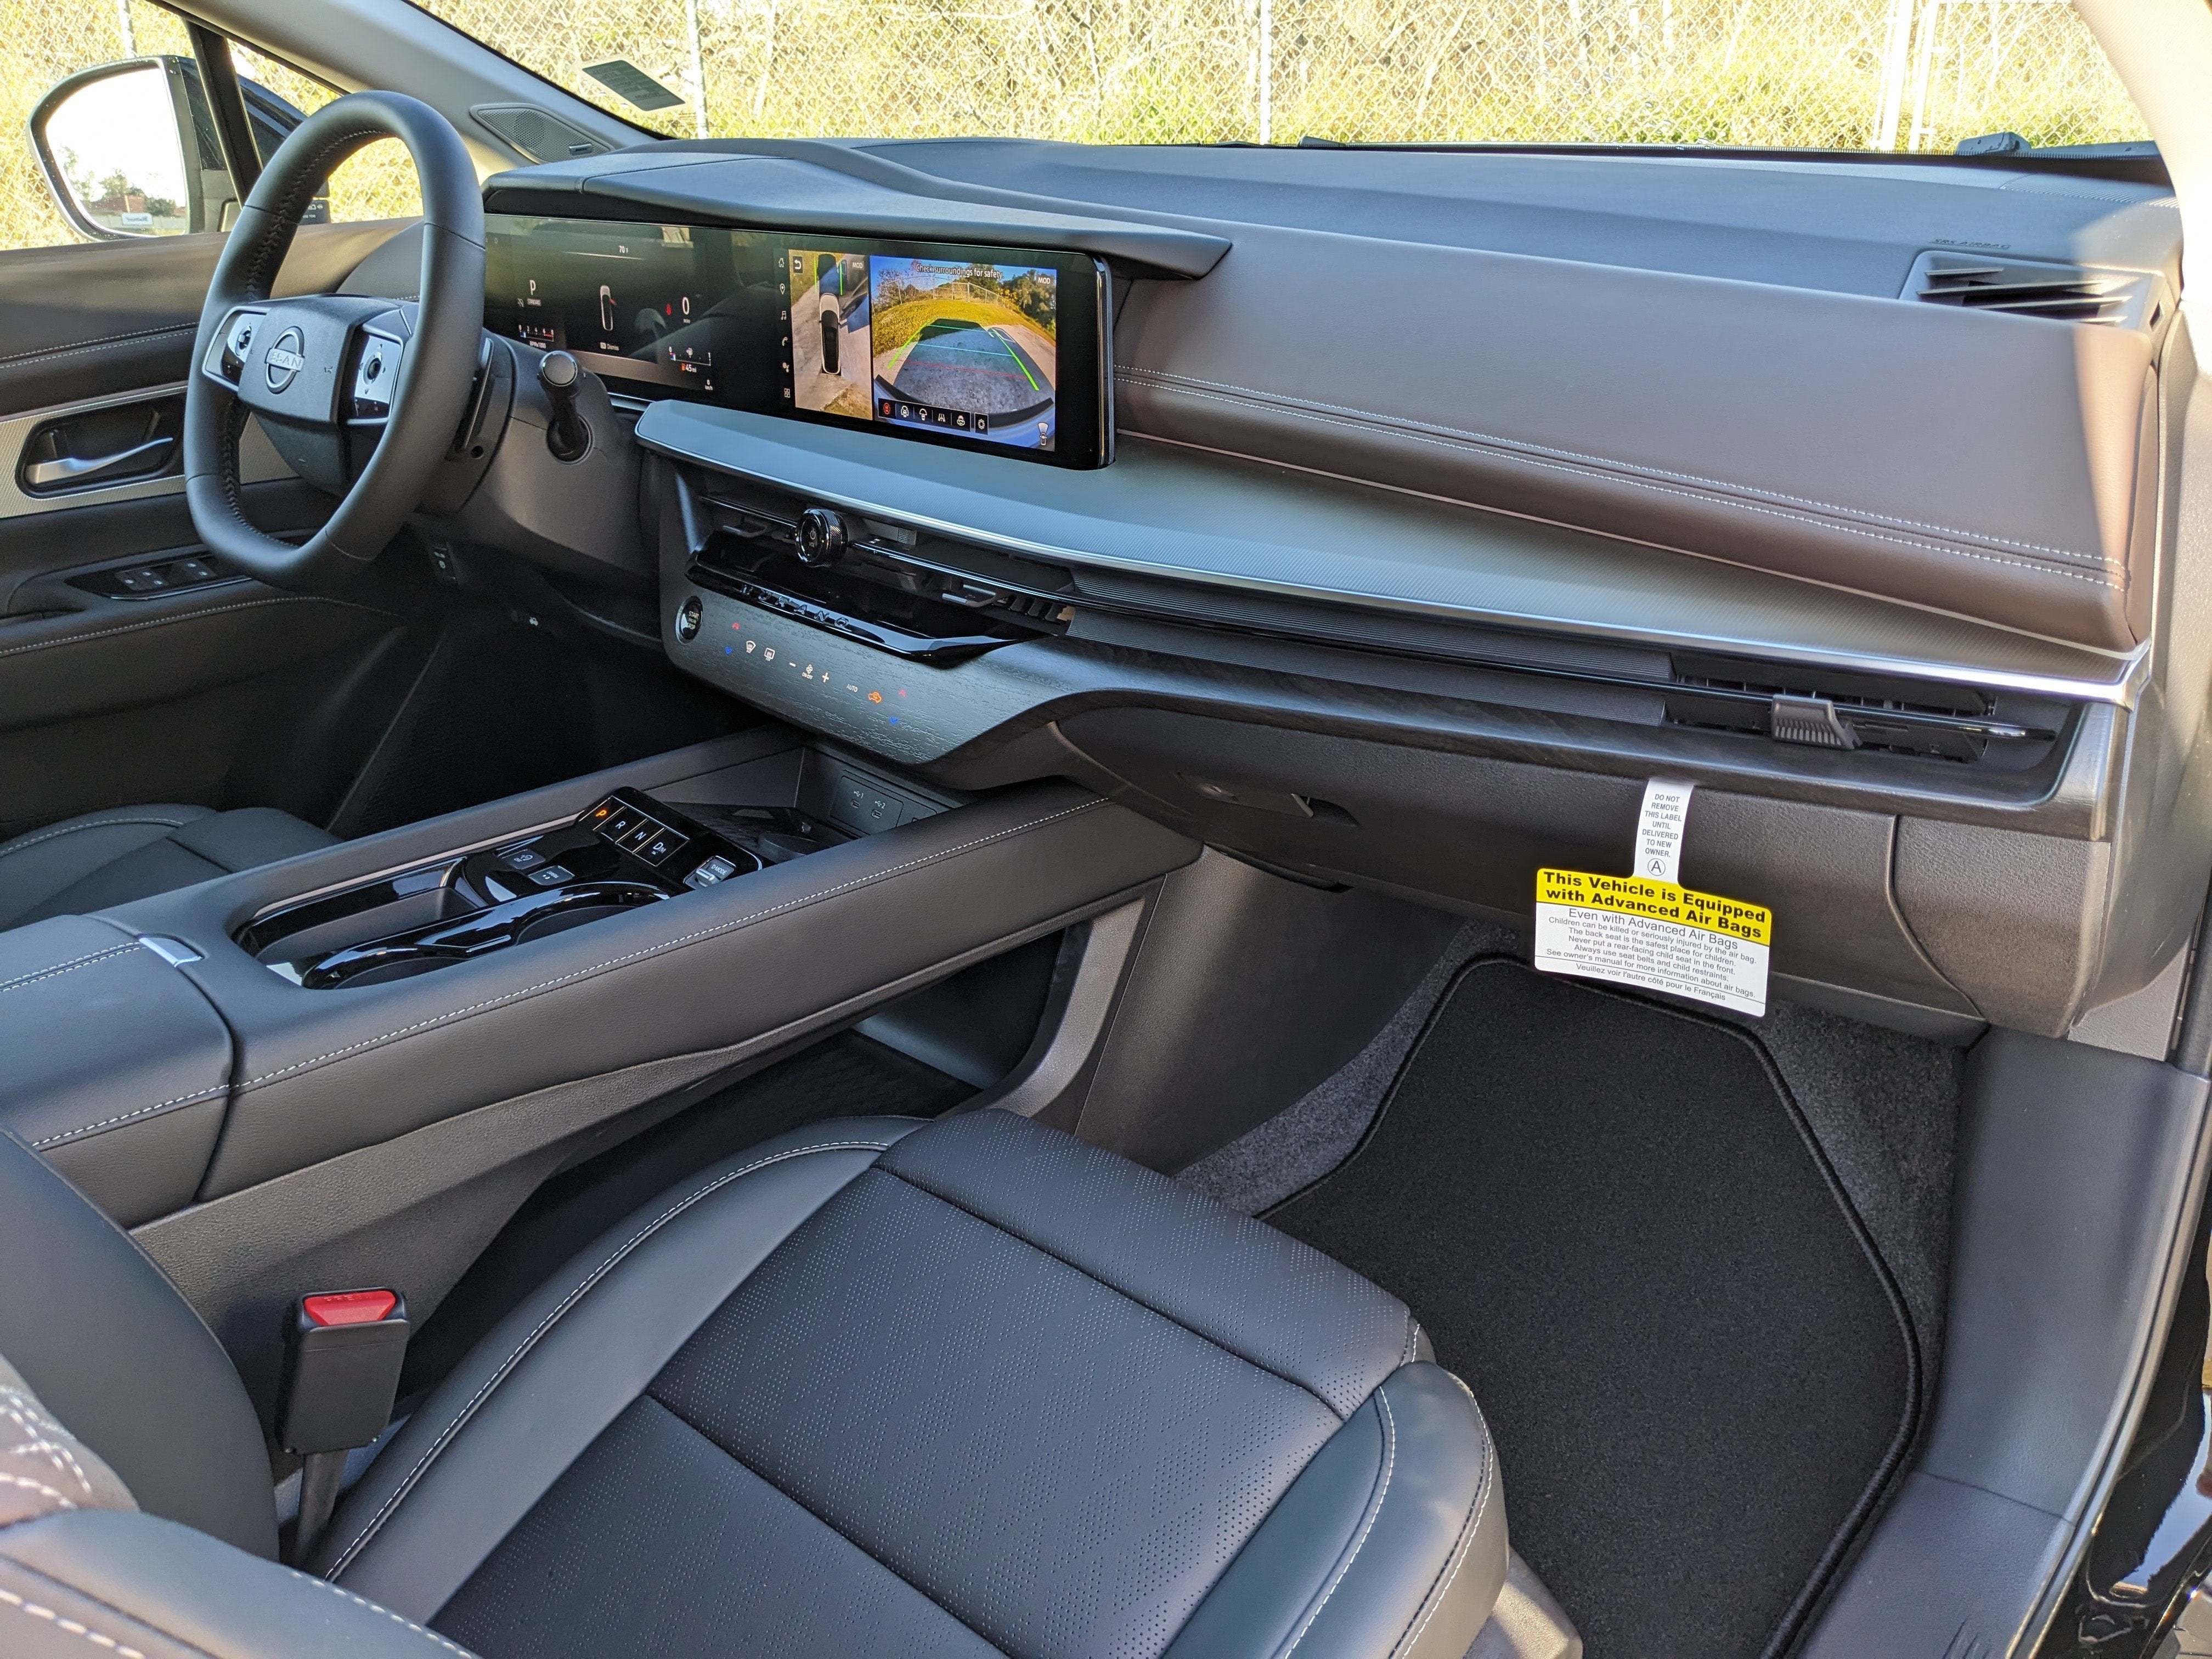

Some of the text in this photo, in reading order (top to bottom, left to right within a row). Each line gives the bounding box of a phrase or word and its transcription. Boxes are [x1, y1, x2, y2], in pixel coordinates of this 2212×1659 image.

[916, 264, 933, 273] Check
[934, 267, 973, 278] surroundings
[973, 268, 984, 277] for
[529, 279, 536, 296] P
[682, 296, 690, 315] 0
[269, 351, 303, 369] SSAN
[689, 611, 699, 619] START
[846, 684, 858, 692] AUTO
[1651, 802, 1679, 812] REMOVE
[1645, 810, 1682, 822] THIS LABEL
[615, 820, 626, 830] R
[1652, 821, 1671, 830] UNTIL
[634, 831, 647, 840] N
[1642, 828, 1679, 840] DELIVERED
[1645, 848, 1671, 857] OWNER.
[1651, 860, 1662, 873] A
[1544, 871, 1765, 923] This Vehicle is Equipped
[1546, 889, 1762, 938] with Advanced Air Bags
[1569, 908, 1738, 950] Even with Advanced Air Bags
[1549, 917, 1580, 927] Children
[1610, 925, 1629, 933] killed
[1641, 932, 1674, 944] seriously
[1677, 938, 1702, 949] injured
[1703, 944, 1713, 952] by
[1715, 947, 1726, 955] the
[1740, 953, 1756, 964] bag.
[1568, 927, 1583, 935] The
[1585, 929, 1603, 938] back
[1632, 937, 1644, 945] the
[1645, 941, 1668, 950] safest
[1670, 945, 1690, 955] place
[1705, 953, 1736, 967] children.
[1568, 935, 1591, 944] Never
[1614, 943, 1654, 957] rear-facing
[1656, 951, 1673, 960] child
[1675, 955, 1692, 964] seat
[1702, 961, 1714, 969] the
[1716, 964, 1735, 975] front.
[1574, 944, 1601, 955] Always
[1637, 954, 1655, 964] belts
[1673, 963, 1690, 972] child
[1692, 968, 1729, 982] restraints.
[1564, 952, 1593, 961] owner's
[1595, 956, 1622, 966] manual
[1637, 963, 1656, 972] more
[1657, 967, 1699, 982] information
[1701, 978, 1722, 988] about
[1735, 986, 1756, 998] bags.
[1576, 963, 1605, 974] Veuillez
[1647, 977, 1663, 985] côté
[1666, 981, 1683, 990] pour
[1694, 986, 1725, 1001] Français
